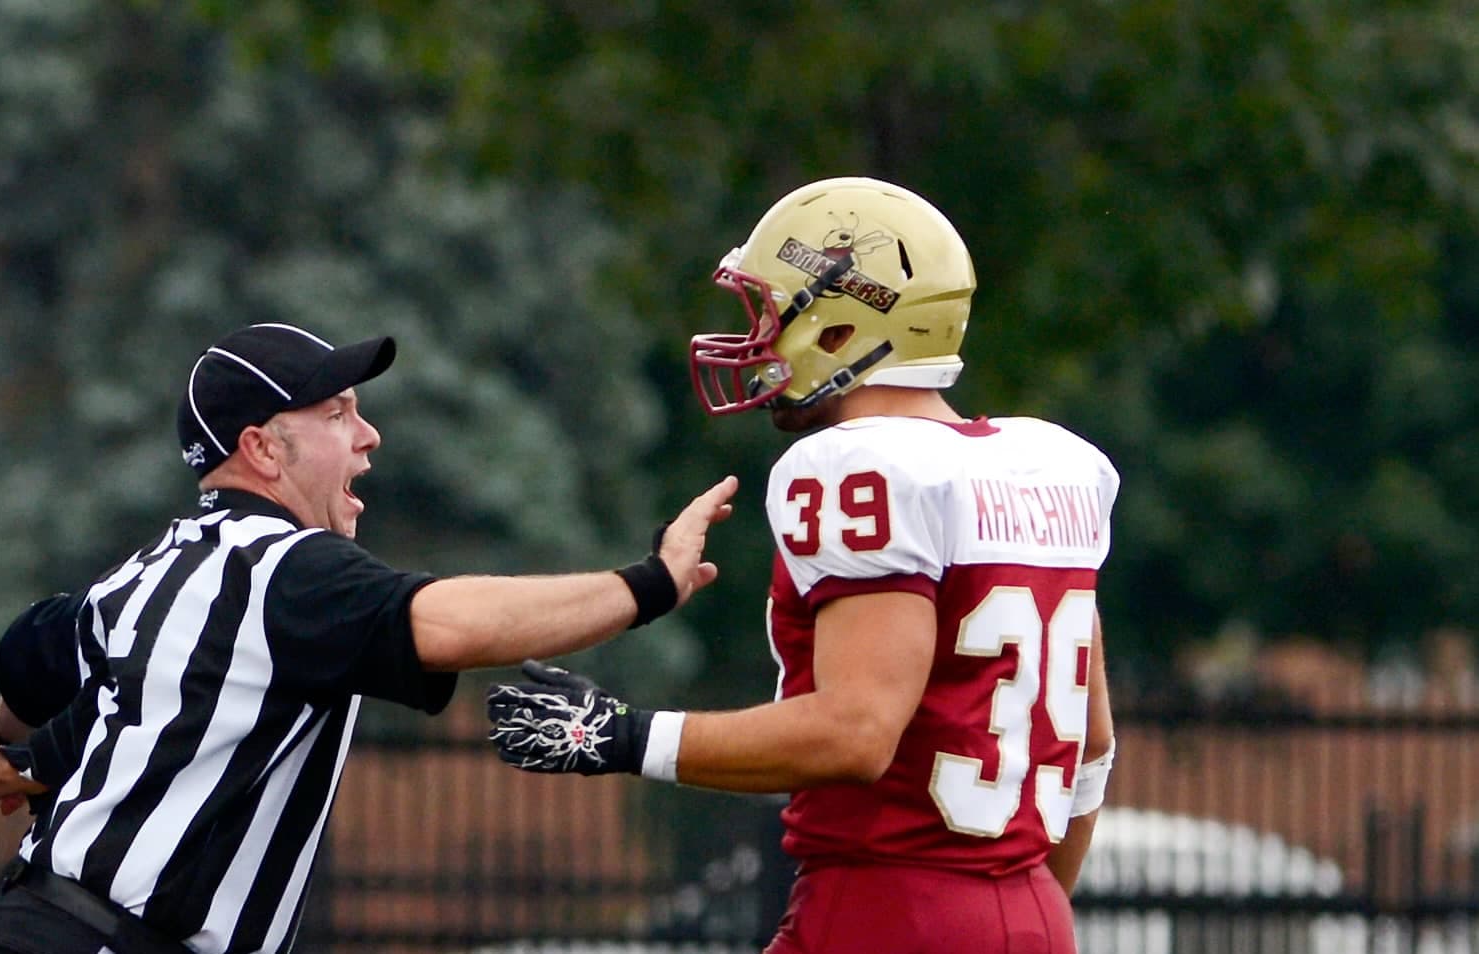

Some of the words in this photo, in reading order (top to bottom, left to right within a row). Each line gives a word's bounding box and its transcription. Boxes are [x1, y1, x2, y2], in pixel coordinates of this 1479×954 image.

[780, 469, 891, 558] 39
[970, 478, 1101, 548] KHATCHIKIA
[928, 584, 1097, 844] 39
